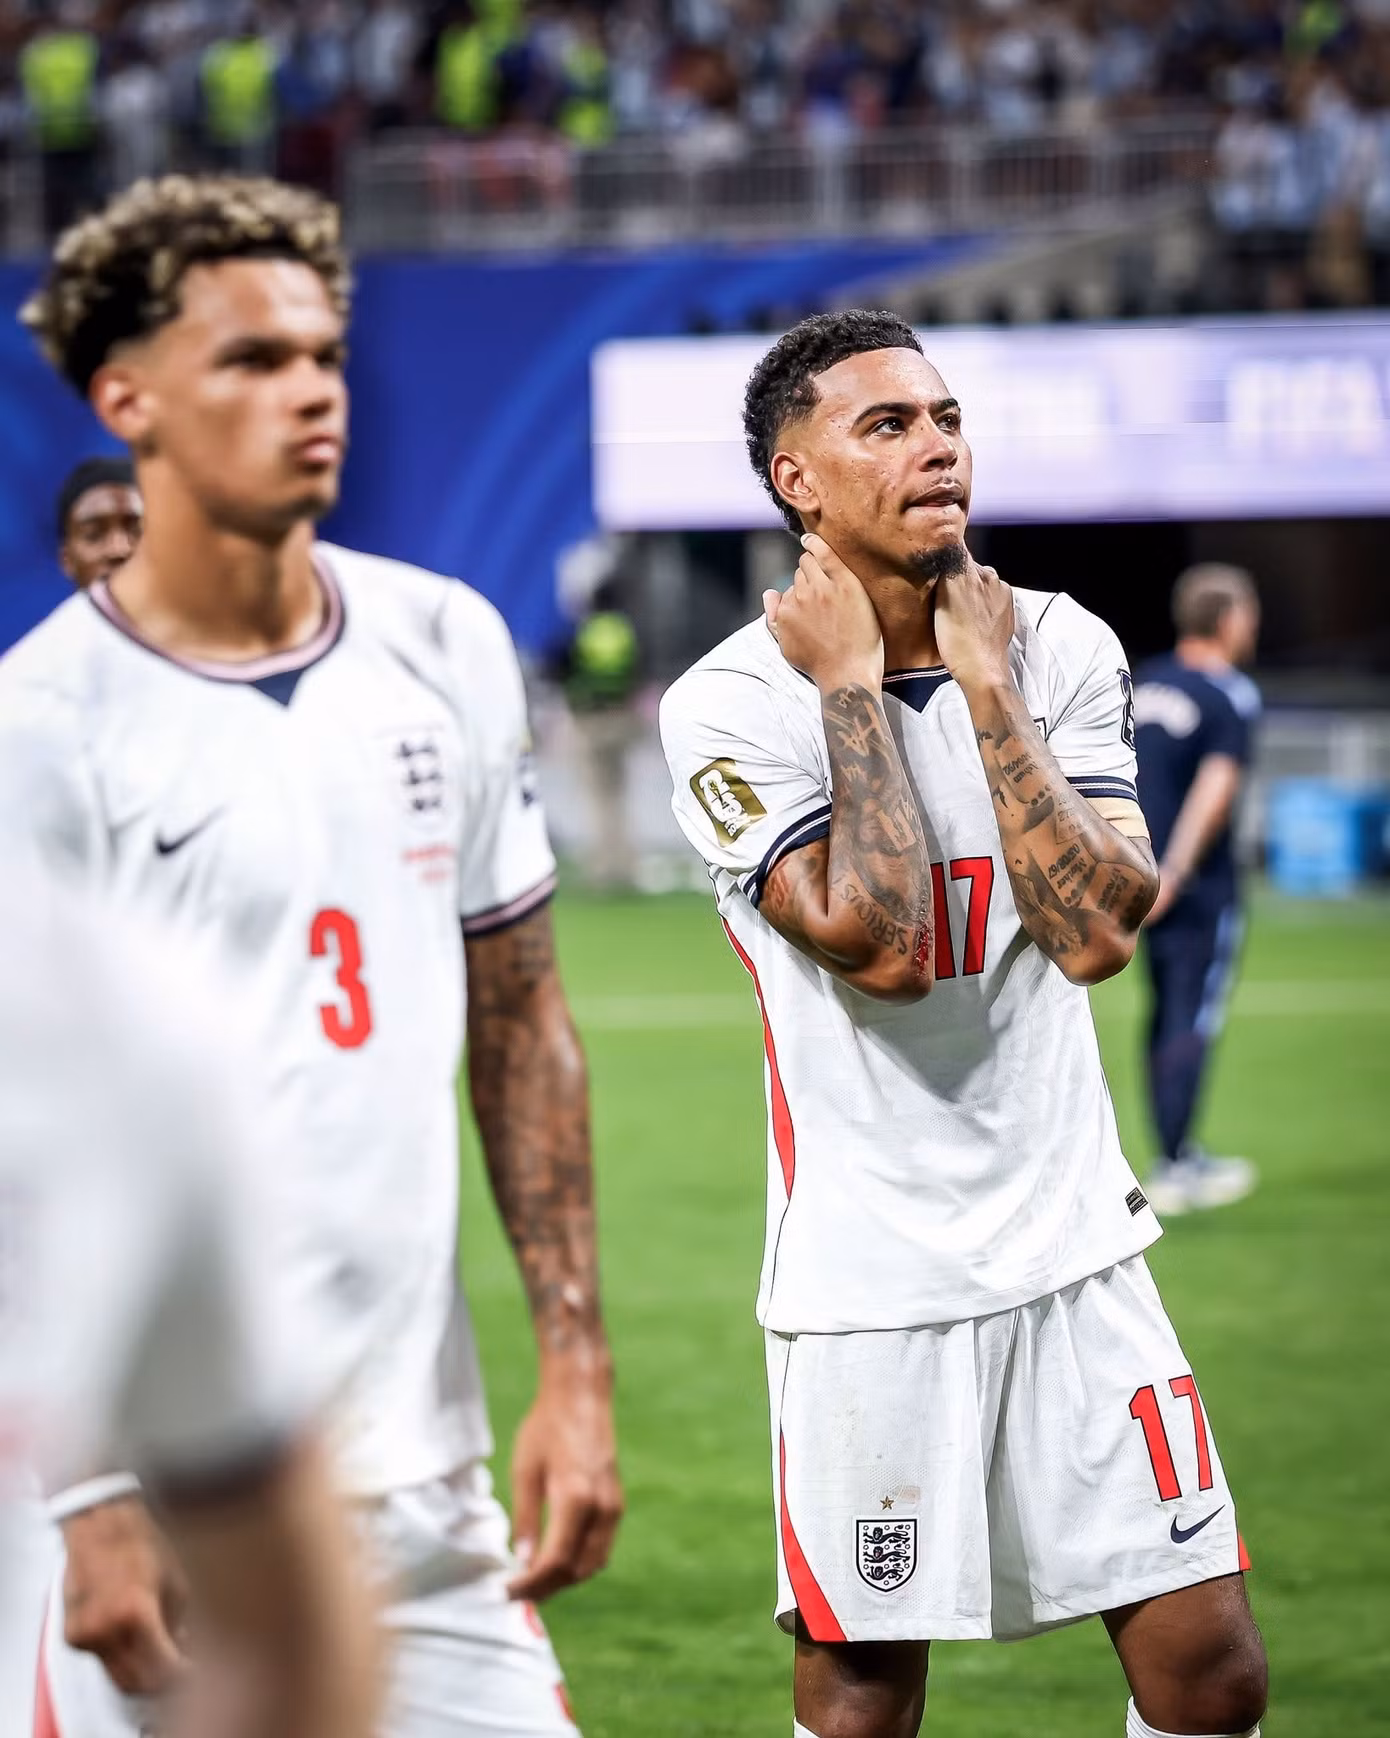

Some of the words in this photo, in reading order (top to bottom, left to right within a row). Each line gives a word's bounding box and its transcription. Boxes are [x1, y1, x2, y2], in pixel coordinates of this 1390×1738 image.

[308, 908, 374, 1050] 3
[929, 856, 994, 980] 17
[1128, 1374, 1214, 1502] 17
